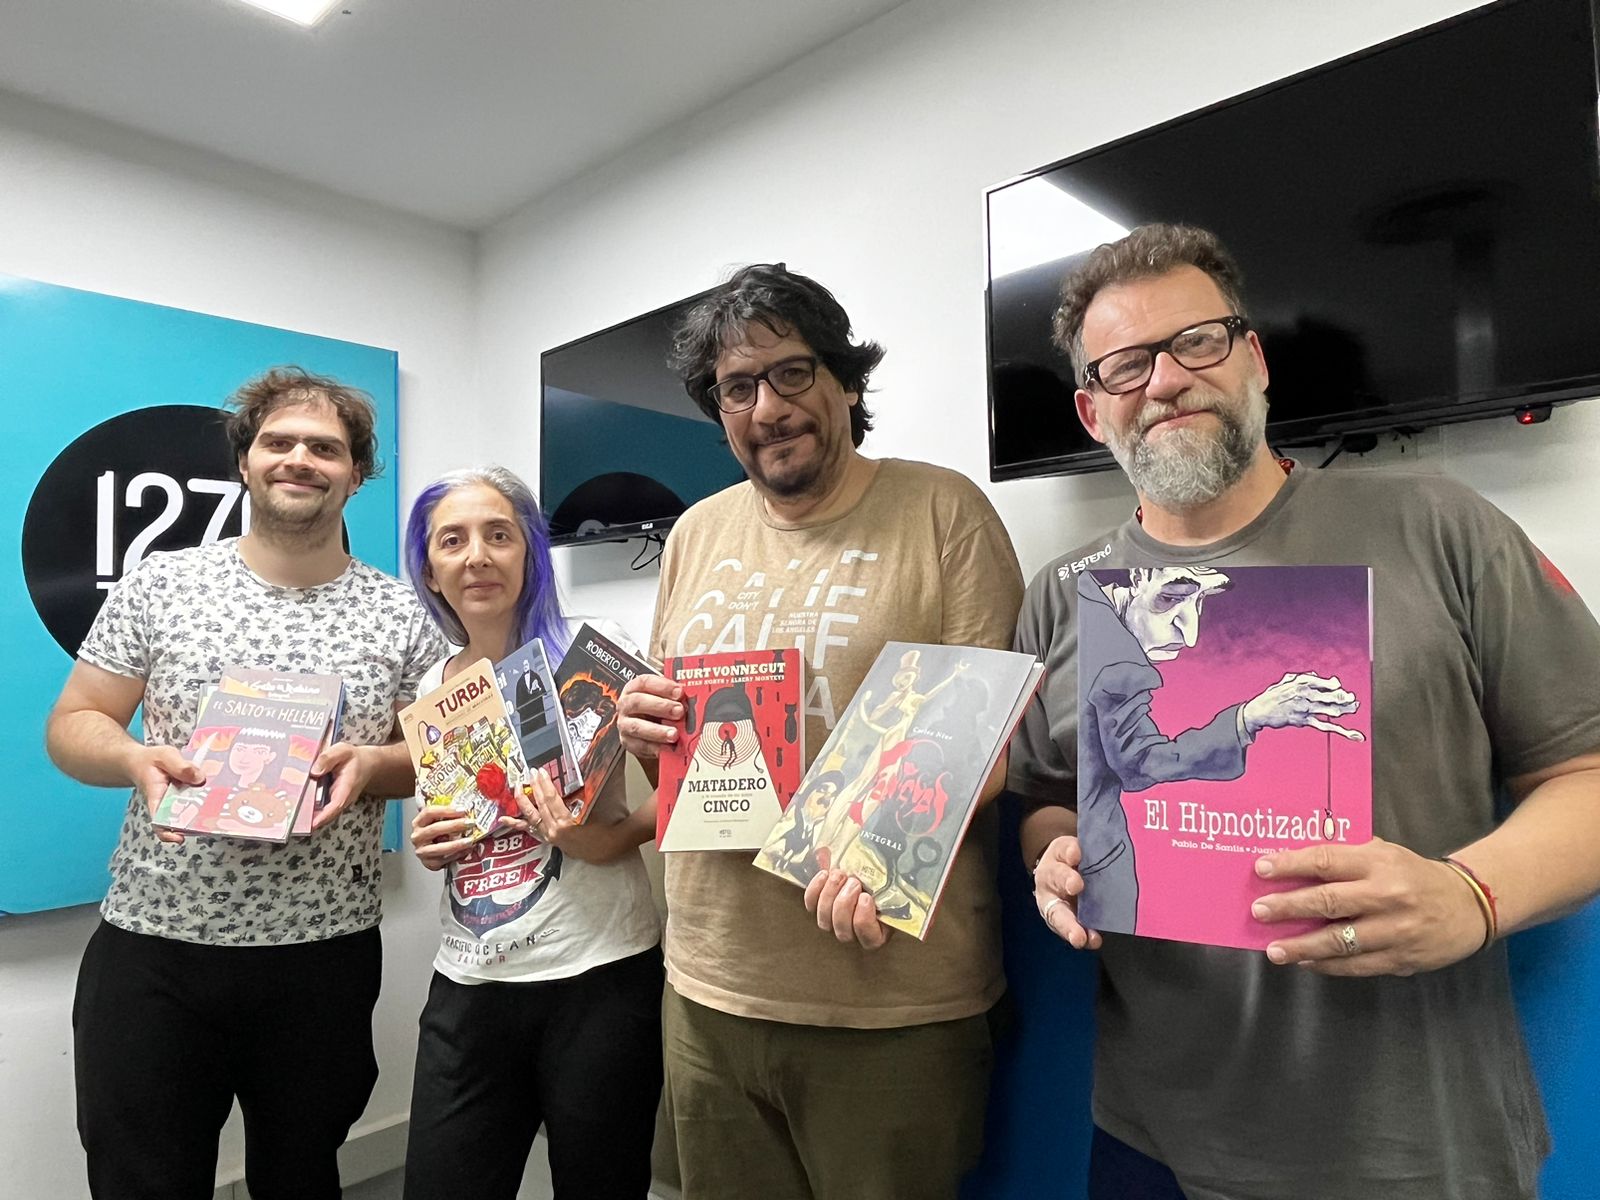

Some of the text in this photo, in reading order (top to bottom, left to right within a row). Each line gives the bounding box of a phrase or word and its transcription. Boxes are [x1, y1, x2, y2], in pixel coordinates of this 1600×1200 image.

[96, 470, 251, 581] 127
[1071, 544, 1111, 573] ESTERO
[586, 640, 620, 670] ROBERTO
[676, 662, 786, 680] KURT VONNEGUT
[435, 674, 491, 718] TURBA
[224, 699, 264, 718] SALTO
[277, 708, 325, 727] HELENA
[688, 777, 767, 793] MATADERO
[703, 799, 751, 813] CINCO
[1144, 799, 1351, 842] El Hipnotizador
[491, 834, 524, 853] BE
[860, 830, 902, 851] INTEGRAL
[1171, 839, 1198, 849] Pablo
[1201, 841, 1214, 850] De
[463, 869, 521, 895] FREE
[445, 934, 536, 955] PACIFIC OCEAN
[457, 954, 506, 966] SAILOR
